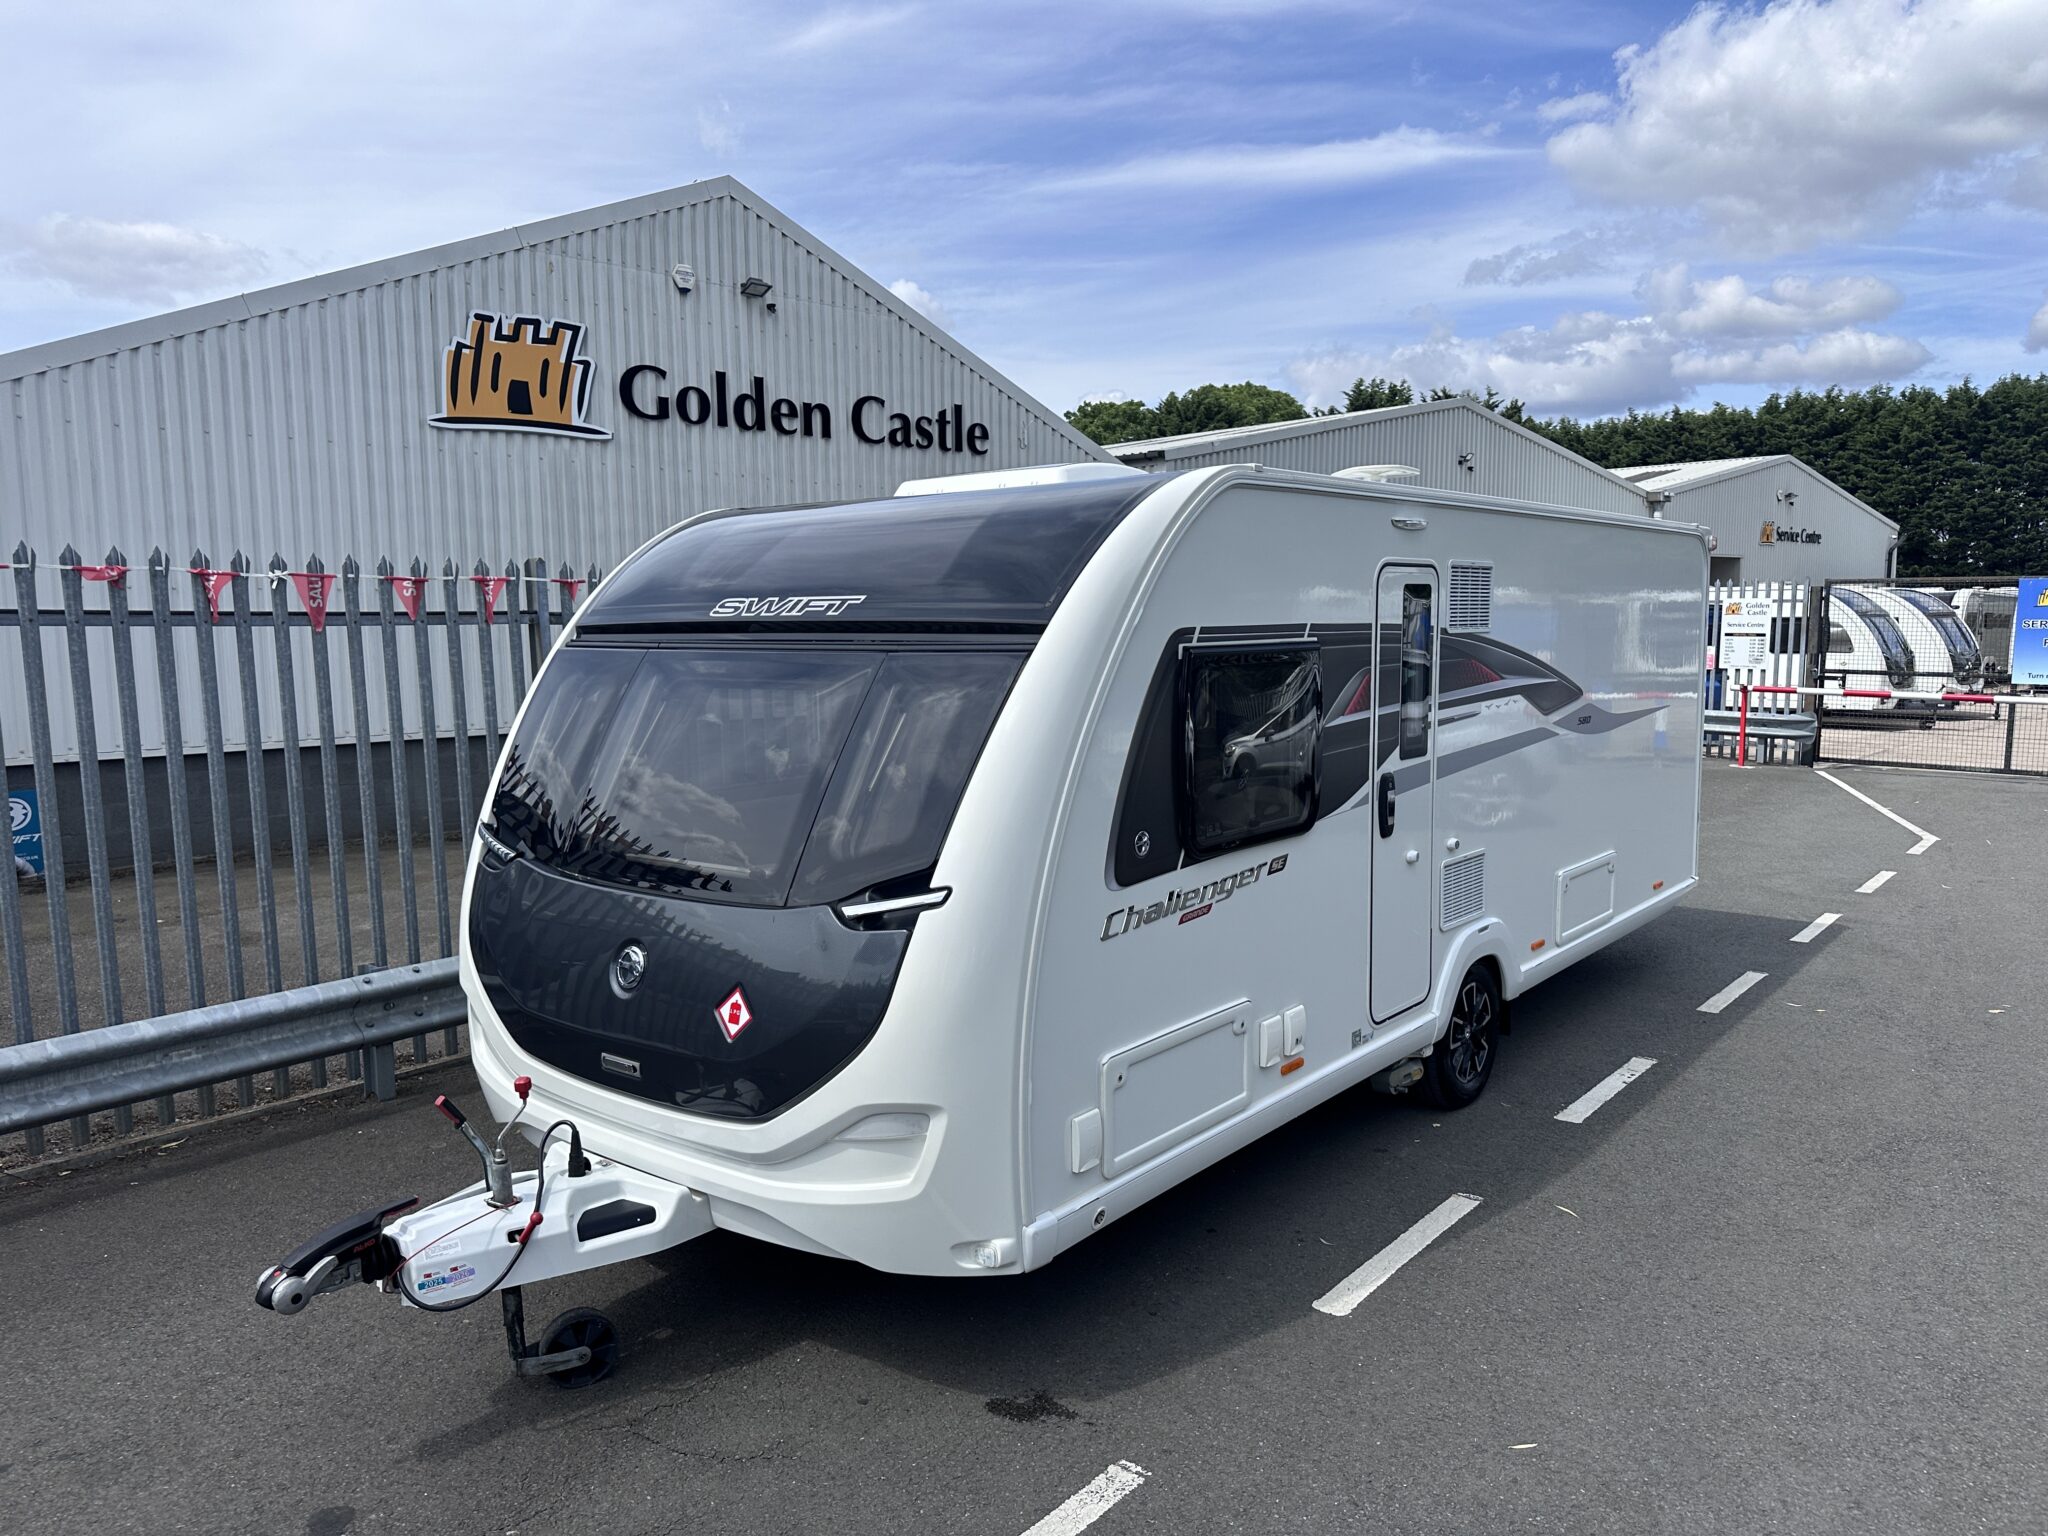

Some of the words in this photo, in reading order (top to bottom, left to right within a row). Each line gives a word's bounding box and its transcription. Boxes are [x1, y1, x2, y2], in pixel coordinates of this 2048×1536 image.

[619, 364, 832, 440] Golden
[851, 395, 990, 456] Castle
[1776, 526, 1799, 543] Service
[1801, 528, 1822, 544] Centre
[709, 594, 868, 617] SWIFT
[1100, 861, 1268, 941] Challenger
[1271, 857, 1286, 872] SE
[1182, 904, 1210, 922] GRANDE
[424, 1278, 443, 1288] 2025
